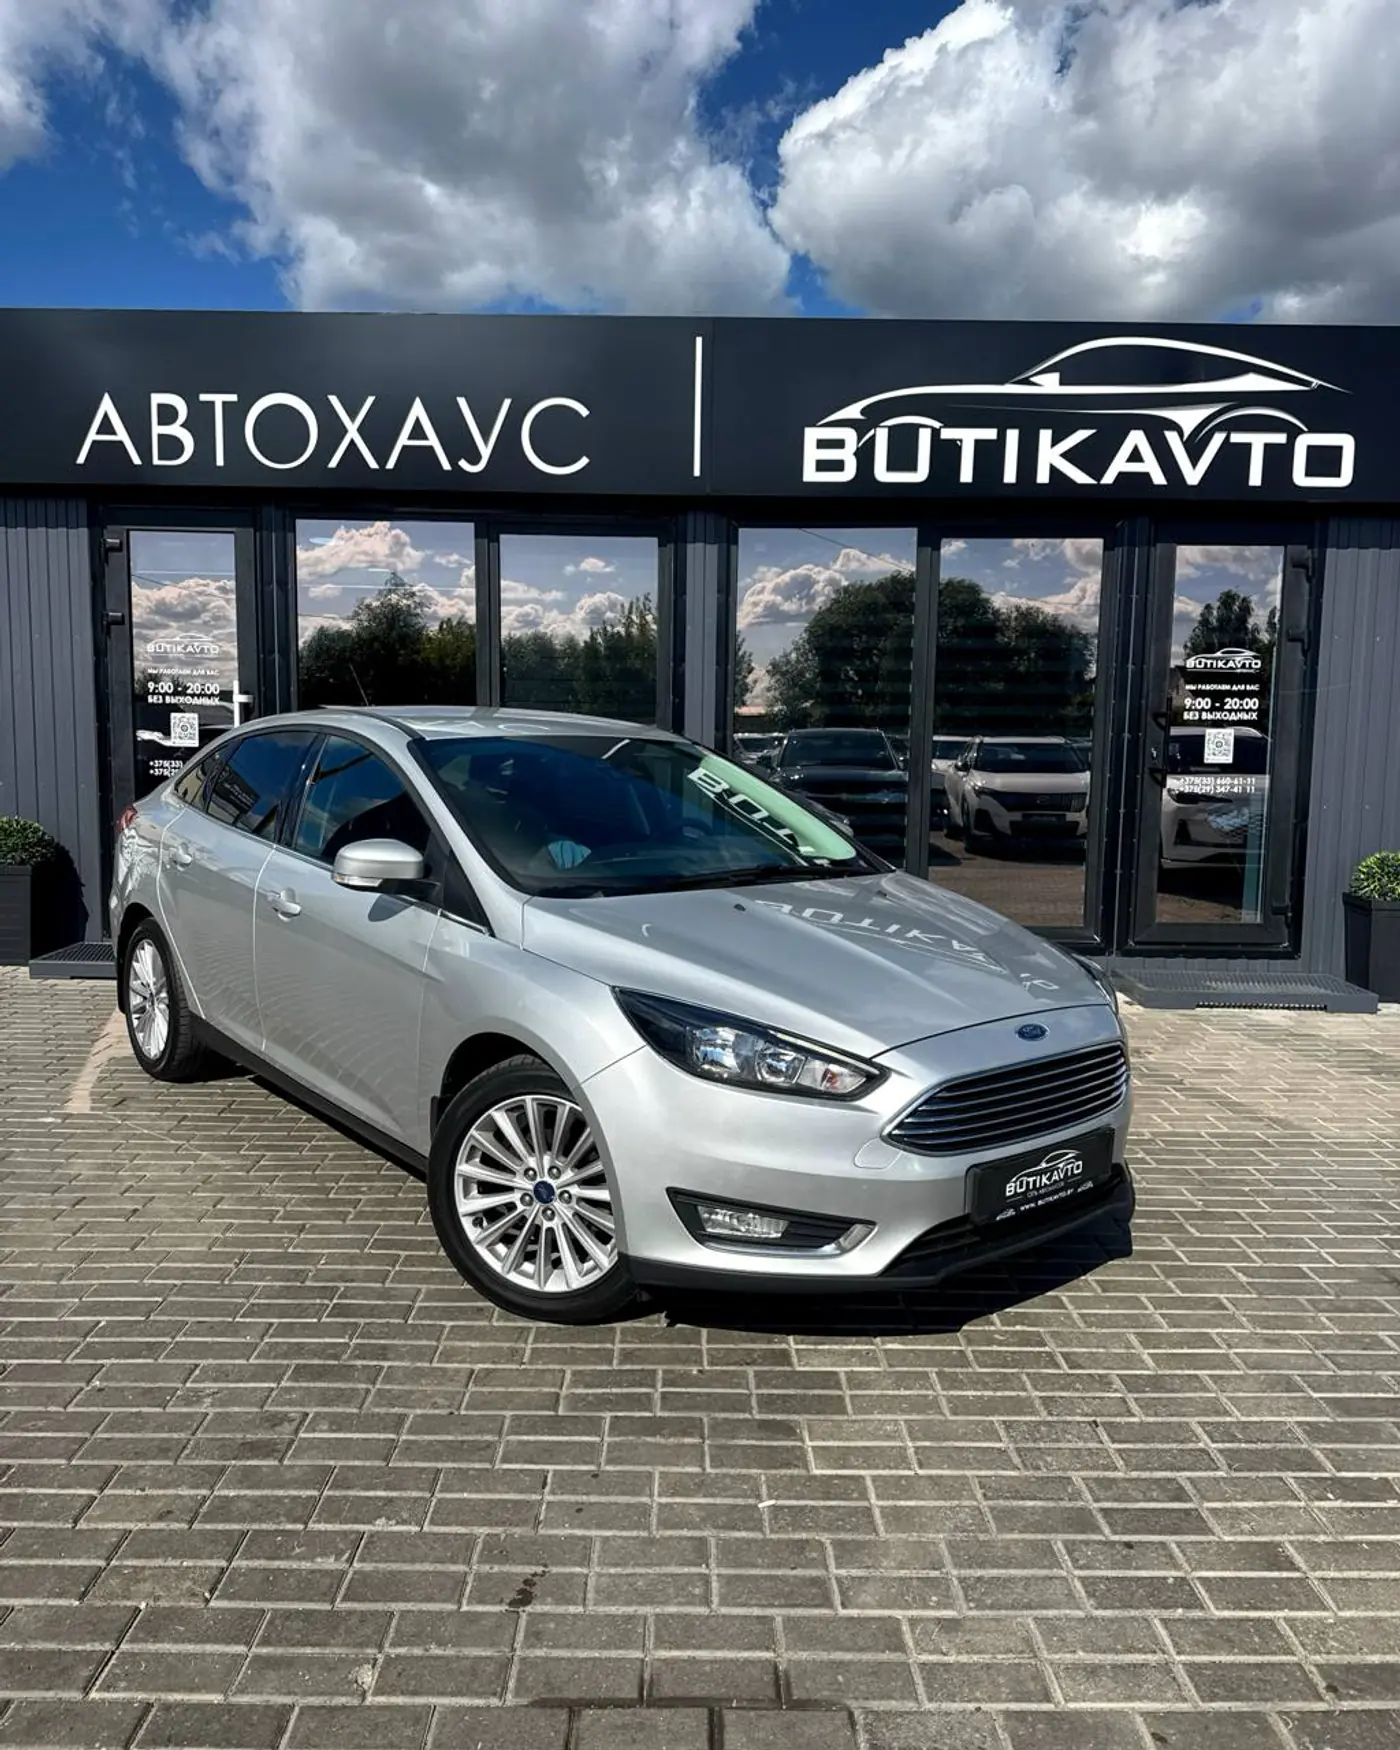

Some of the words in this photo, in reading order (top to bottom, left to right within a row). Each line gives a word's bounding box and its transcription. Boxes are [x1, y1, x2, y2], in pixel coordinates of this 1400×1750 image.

[76, 392, 590, 476] АВТОХАУС
[802, 426, 1355, 488] BUTIKAVTO
[146, 643, 219, 654] BUTIKAVTO
[1186, 659, 1261, 669] BUTIKAVTO
[148, 681, 173, 694] 9:00
[186, 683, 220, 695] 20:00
[148, 695, 163, 704] БЕЗ
[165, 695, 220, 705] ВЫХОДНЫХ
[1184, 698, 1211, 710] 9:00
[1224, 698, 1259, 710] 20:00
[1183, 712, 1199, 720] БЕЗ
[1201, 712, 1258, 721] ВЫХОДНЫХ
[1005, 1161, 1083, 1197] BUTIKAVTO
